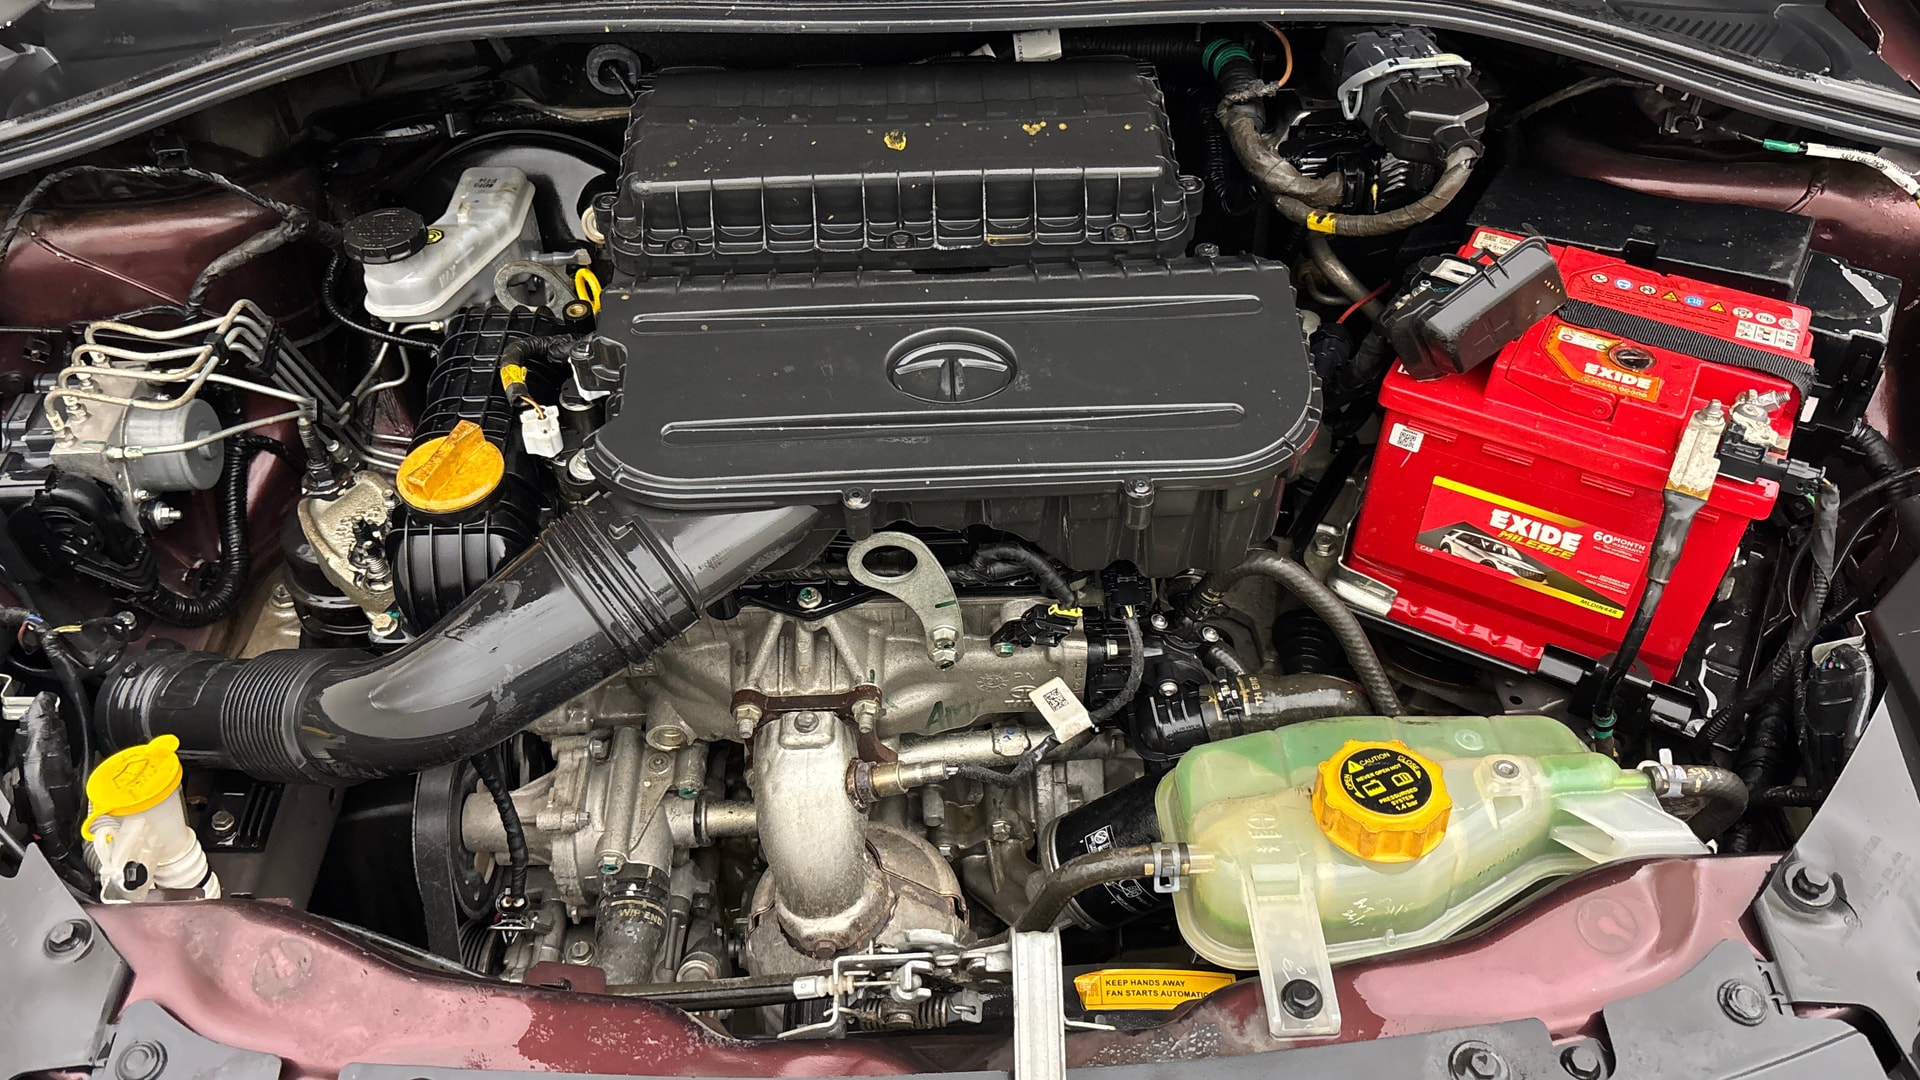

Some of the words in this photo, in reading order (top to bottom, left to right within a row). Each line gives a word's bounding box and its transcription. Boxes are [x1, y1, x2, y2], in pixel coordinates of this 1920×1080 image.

[1584, 362, 1652, 390] EXIDE
[1489, 508, 1583, 553] EXIDE
[1419, 545, 1434, 554] CAR
[1499, 530, 1576, 561] MILEAGE
[1593, 531, 1613, 544] 60
[1613, 537, 1645, 551] MONTH
[1580, 599, 1618, 616] MLDIN44R
[1254, 692, 1264, 707] TH
[1359, 752, 1391, 767] CAUTION
[1397, 755, 1421, 772] CLOSE
[1355, 772, 1375, 783] NEVER
[1374, 767, 1391, 776] OPEN
[1389, 763, 1402, 771] HOT
[1343, 773, 1354, 791] OPEN
[1390, 794, 1415, 806] SYSTEM
[643, 911, 663, 926] END
[1105, 979, 1128, 987] KEEP
[1130, 979, 1160, 987] HANDS
[1125, 989, 1158, 997] STARTS
